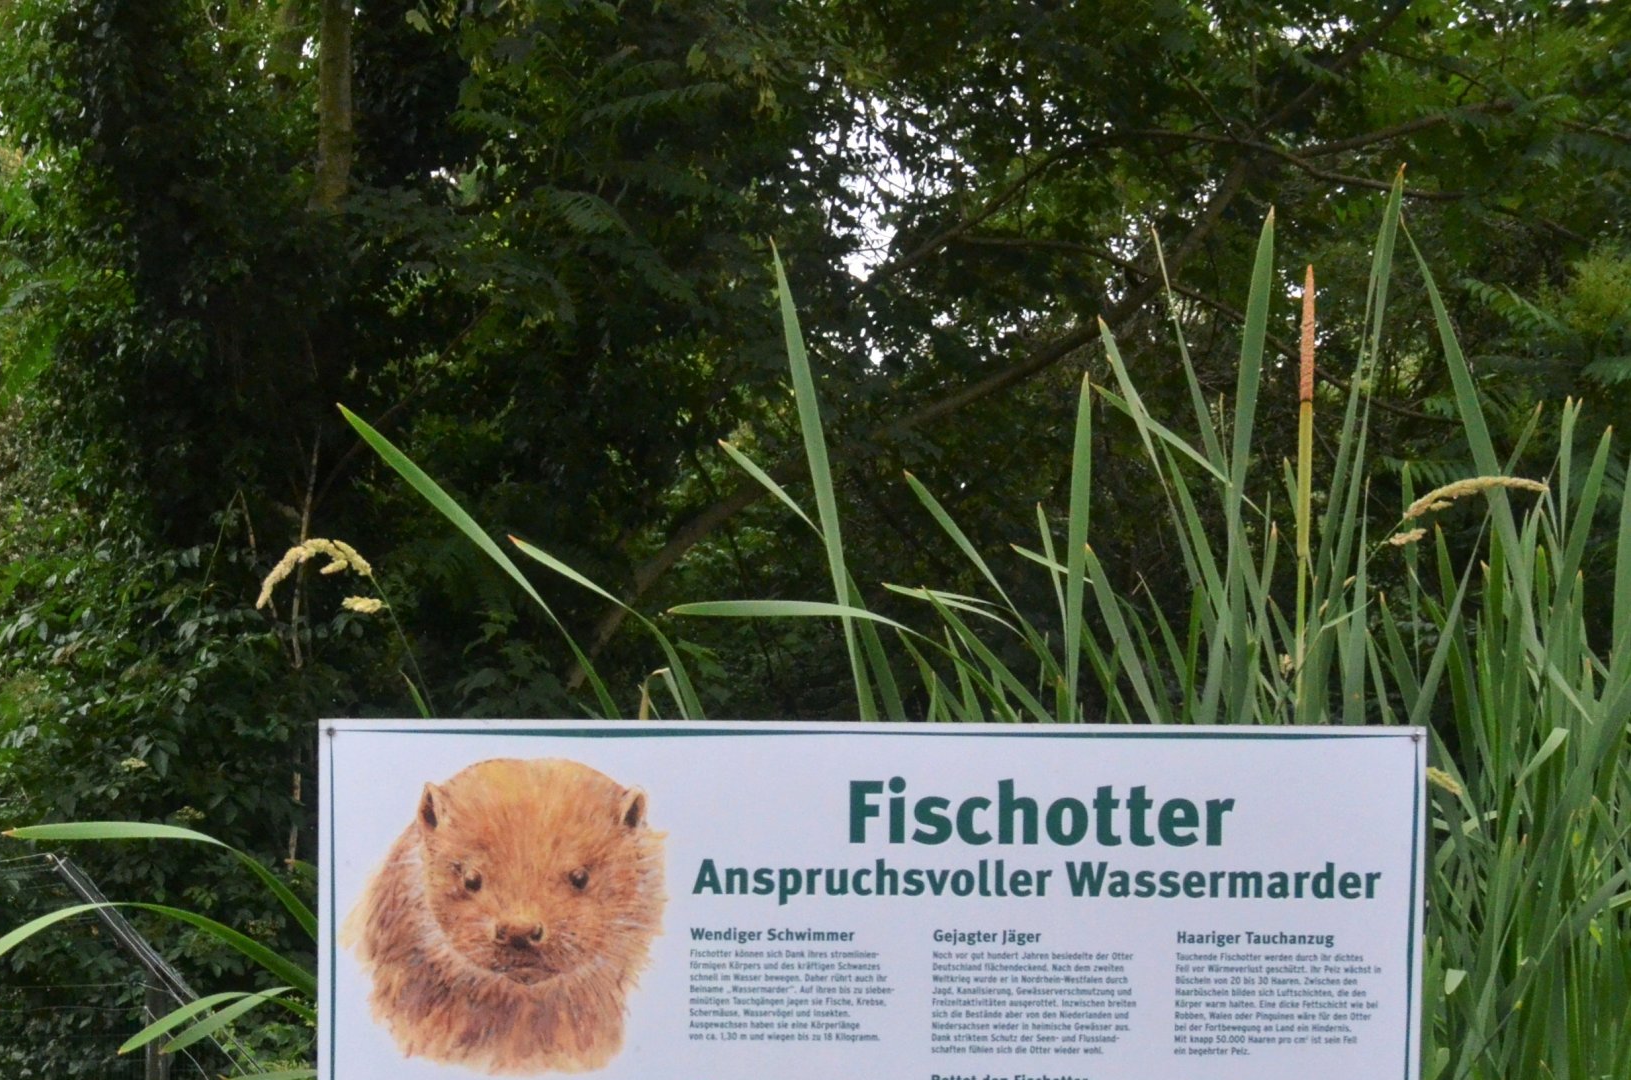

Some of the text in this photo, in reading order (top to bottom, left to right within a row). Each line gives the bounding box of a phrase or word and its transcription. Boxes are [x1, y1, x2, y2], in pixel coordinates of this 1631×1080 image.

[849, 775, 1236, 848] Fischotter
[692, 858, 1382, 906] Anspruchsvoller Wassermarder
[690, 928, 855, 944] Wendiger Schwimmer
[933, 929, 1042, 946] Gejagter Jäger
[1177, 931, 1335, 948] Haariger Tauchanzug
